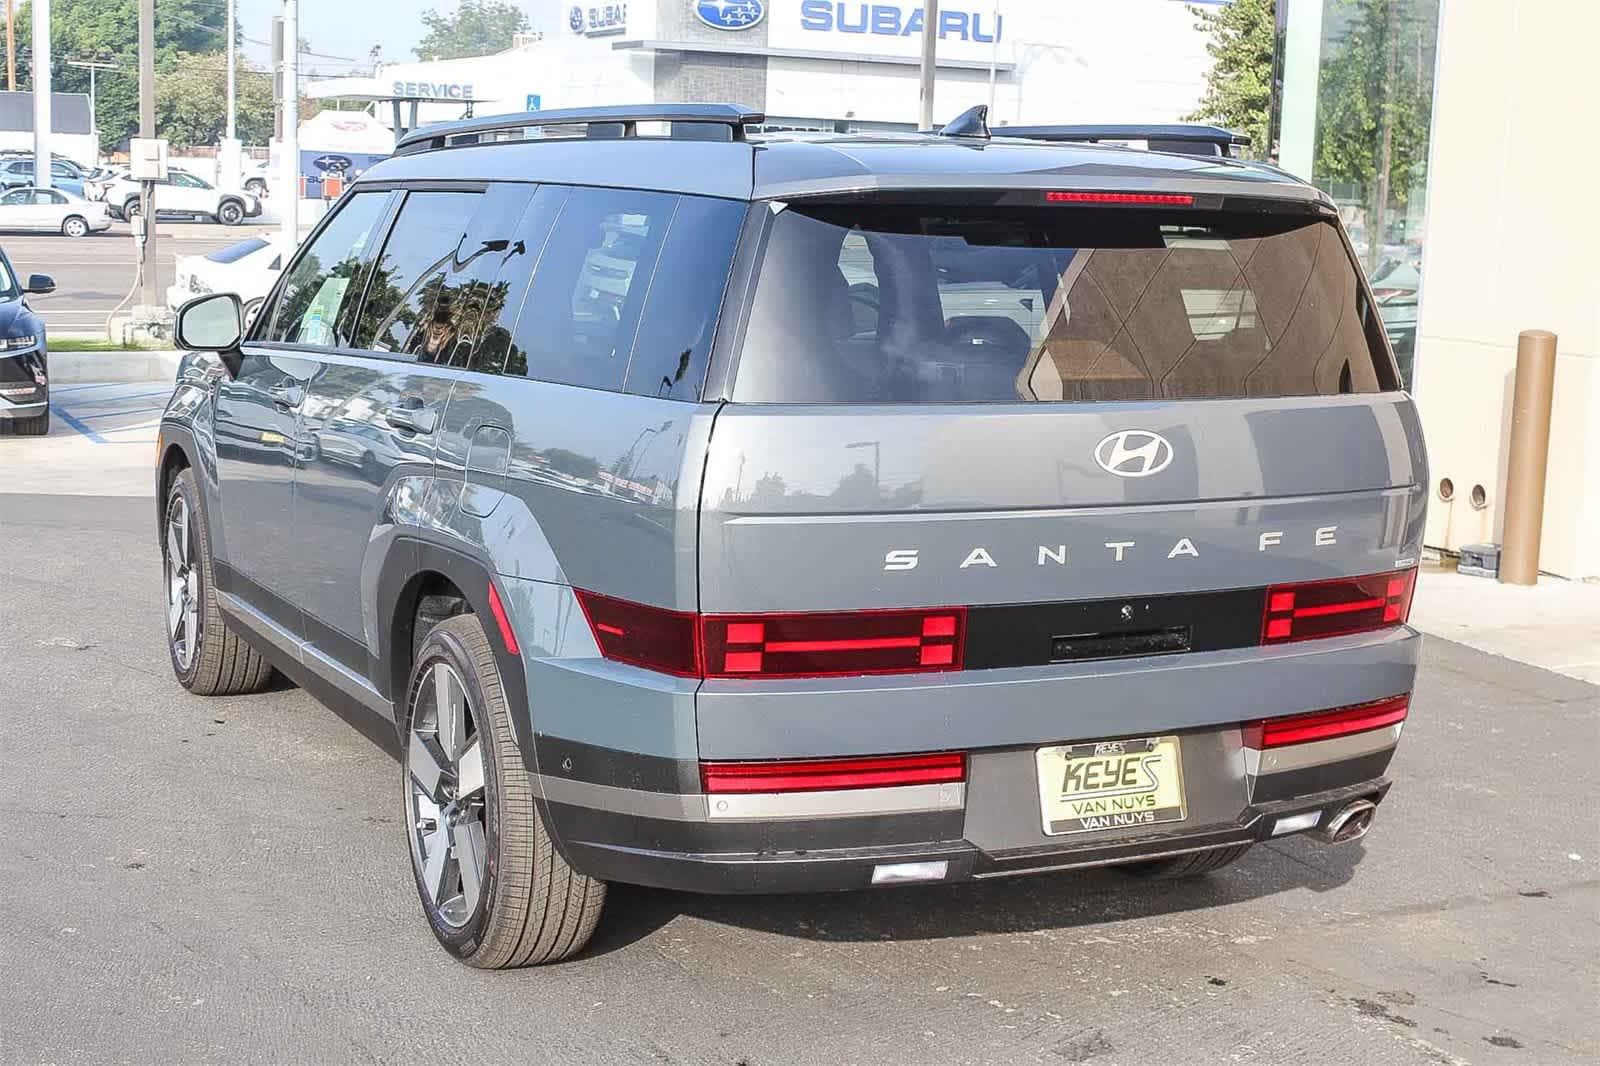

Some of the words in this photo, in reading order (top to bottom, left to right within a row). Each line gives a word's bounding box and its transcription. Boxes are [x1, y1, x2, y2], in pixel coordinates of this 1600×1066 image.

[588, 4, 626, 28] SUBA
[801, 0, 1002, 43] SUBARU
[393, 81, 473, 98] SERVICE
[883, 538, 1200, 571] SANTA
[1258, 525, 1338, 551] FE
[1061, 754, 1162, 795] KEYES
[1072, 800, 1107, 814] VAN
[1112, 795, 1156, 810] NUYS
[1080, 814, 1110, 829] VAN
[1114, 811, 1155, 826] NUYS
